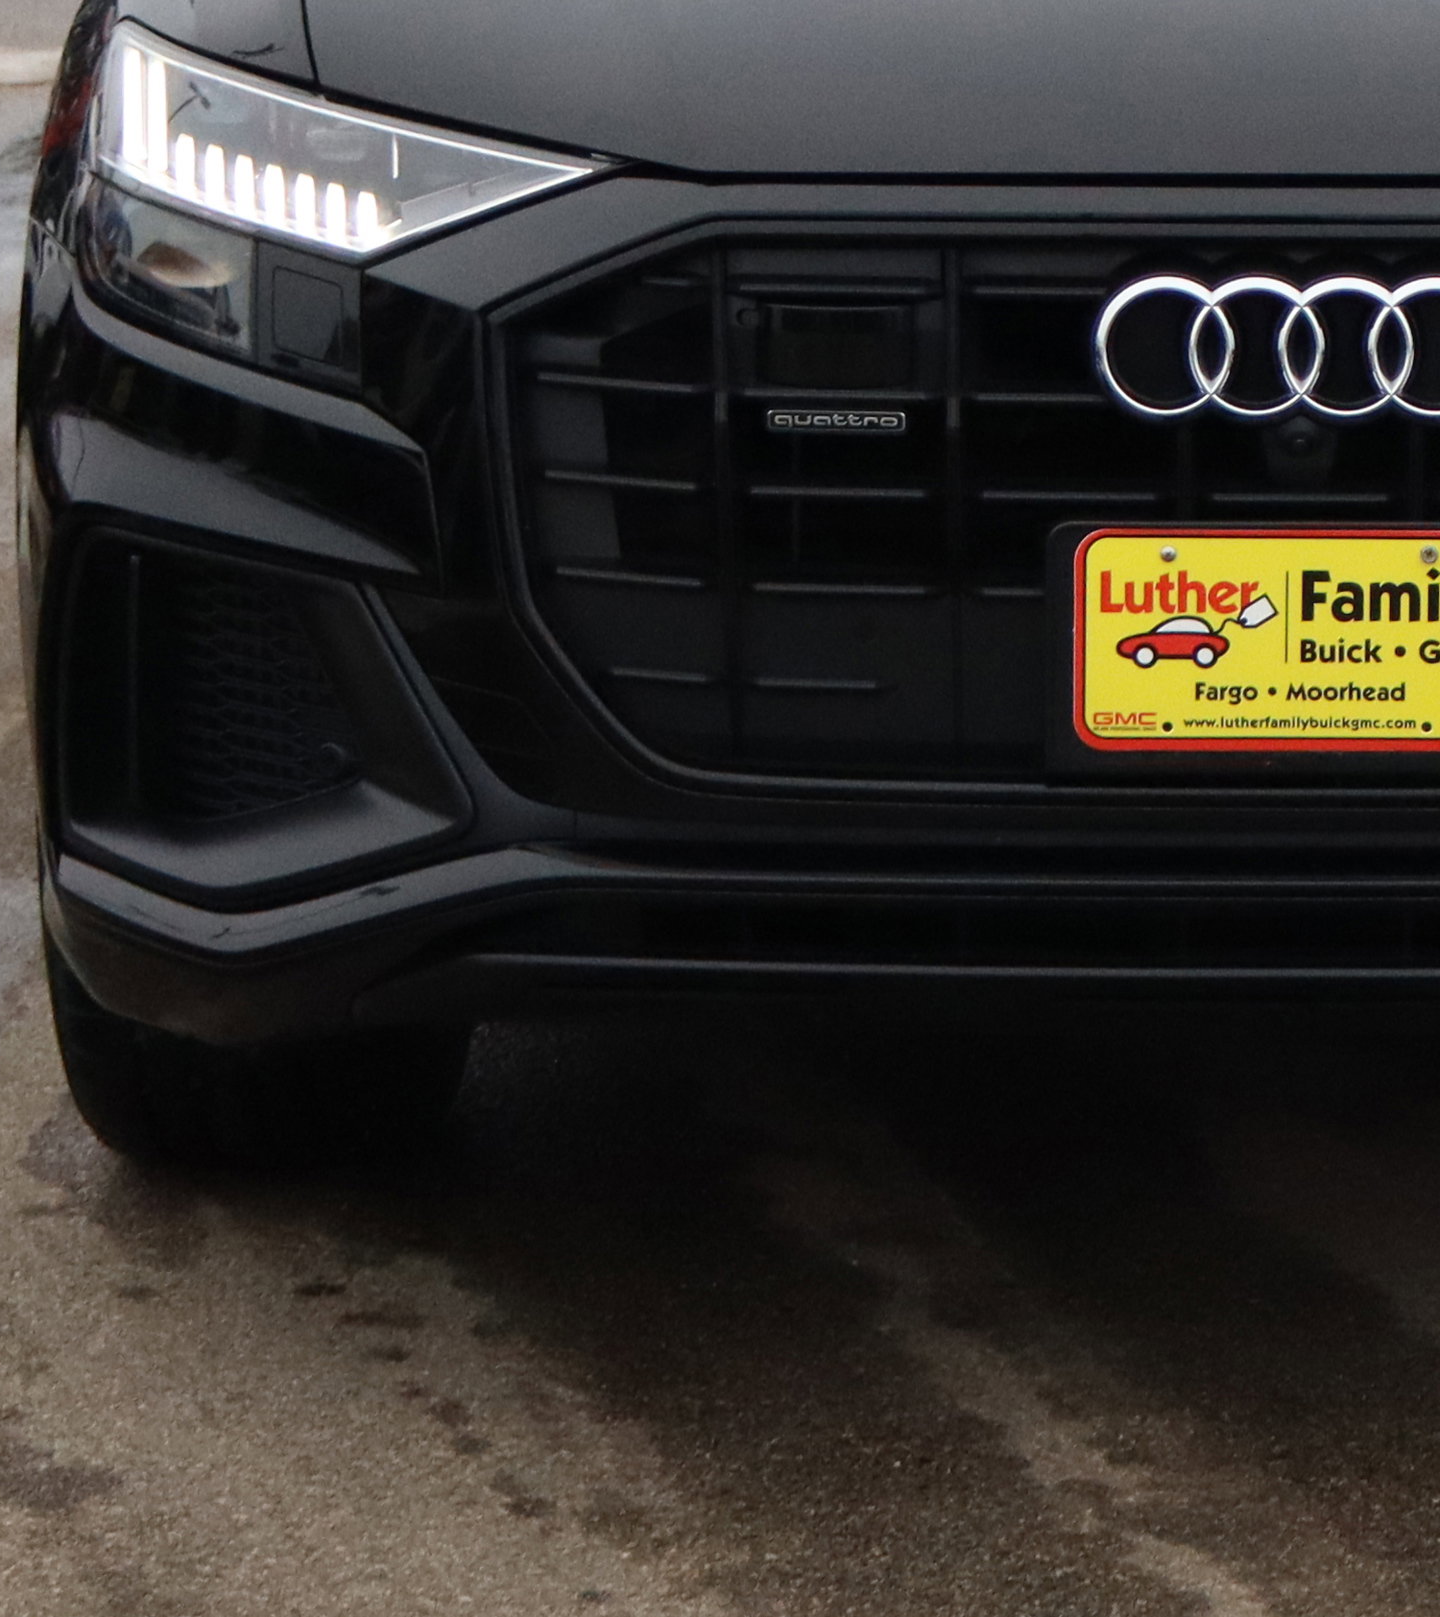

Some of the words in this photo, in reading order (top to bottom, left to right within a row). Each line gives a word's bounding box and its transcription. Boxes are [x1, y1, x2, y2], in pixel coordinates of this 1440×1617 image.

[774, 413, 899, 428] quattro
[1099, 570, 1260, 614] Luther
[1299, 638, 1383, 665] Buick
[1194, 681, 1260, 704] Fargo
[1285, 681, 1407, 703] Moorhead
[1092, 711, 1158, 726] GMC
[1183, 716, 1418, 731] www.lutherfamilybuickgmc.com
